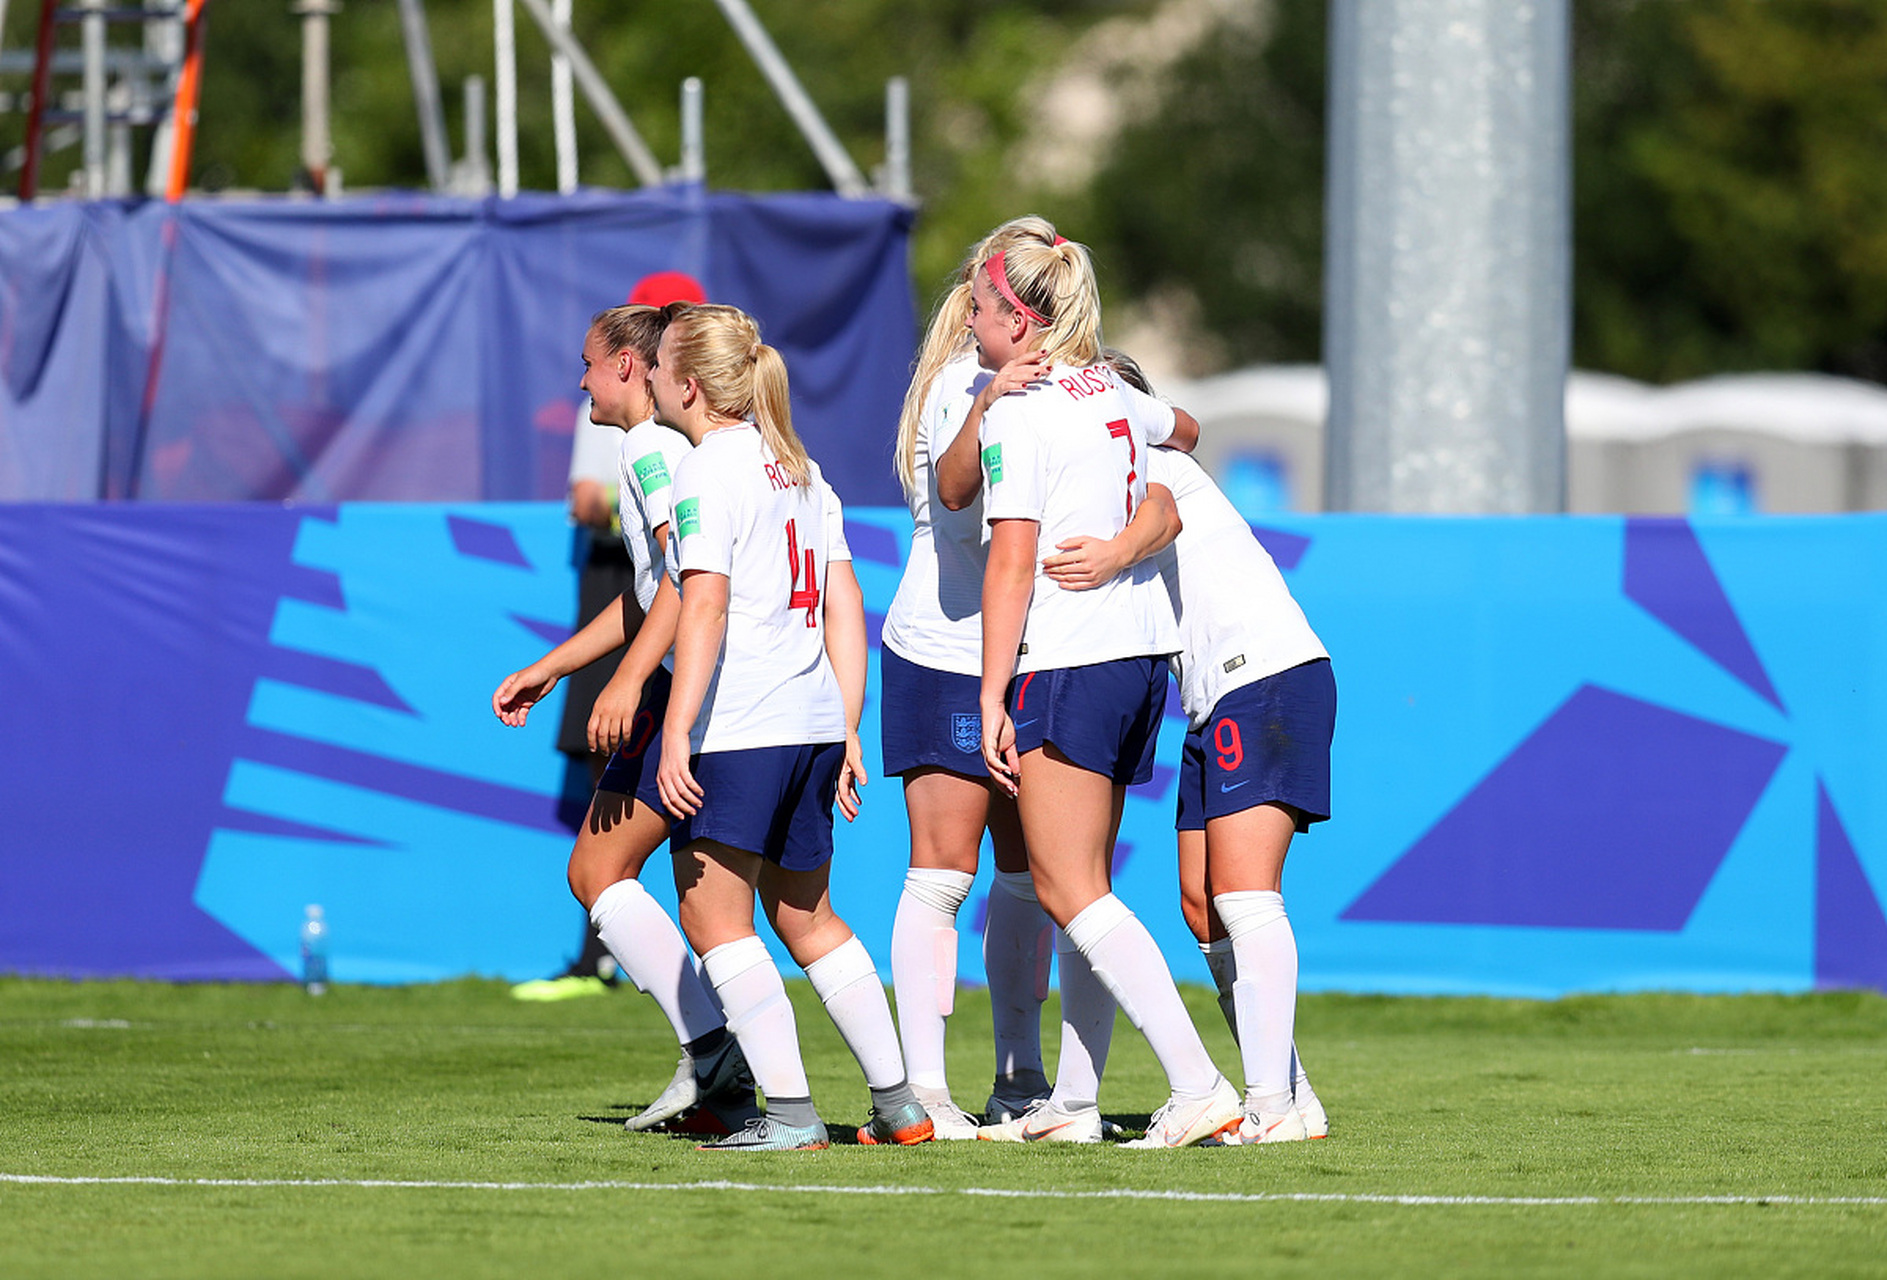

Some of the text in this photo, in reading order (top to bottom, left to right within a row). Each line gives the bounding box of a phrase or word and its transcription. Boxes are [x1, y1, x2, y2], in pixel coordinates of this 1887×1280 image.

[1106, 418, 1137, 527] 7
[785, 518, 820, 628] 4
[1213, 717, 1245, 772] 9
